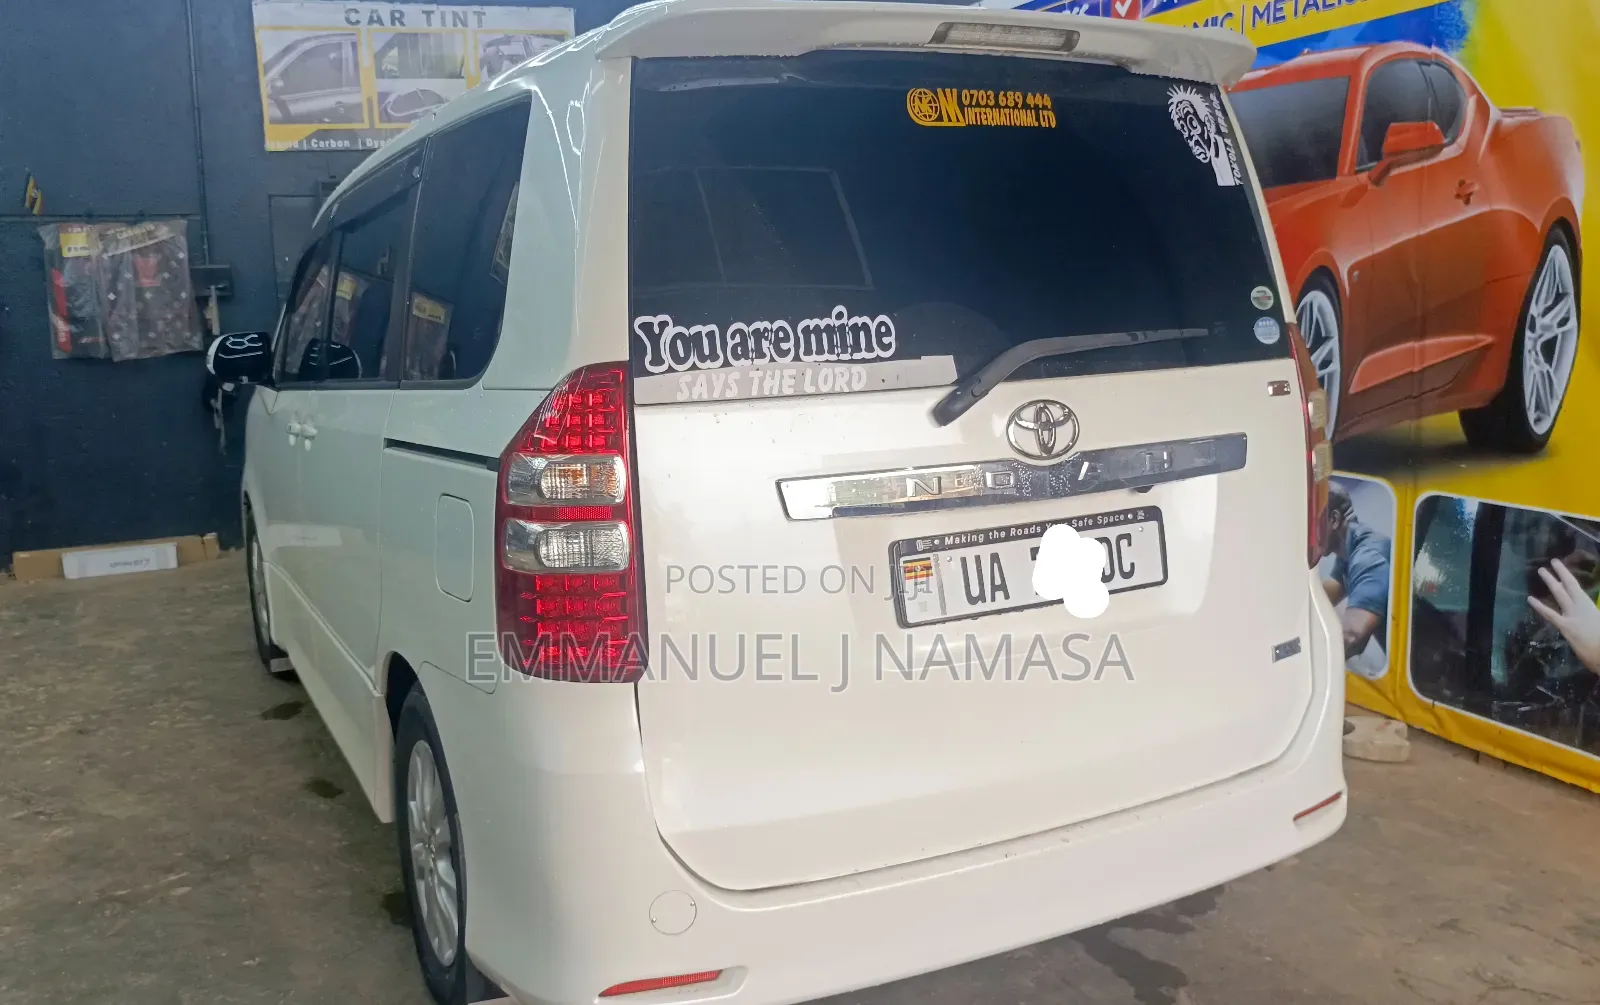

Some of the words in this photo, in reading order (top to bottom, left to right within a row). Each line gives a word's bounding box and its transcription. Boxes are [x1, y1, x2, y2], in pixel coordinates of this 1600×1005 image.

[344, 8, 406, 27] CAR
[421, 10, 486, 28] TINT
[1251, 0, 1358, 30] METAL
[961, 89, 995, 106] 0703
[998, 91, 1023, 107] 689
[1026, 92, 1052, 109] 444
[964, 107, 1039, 128] INTERNATIONAL
[1040, 110, 1057, 128] LTD
[311, 138, 350, 149] Carbon
[634, 314, 724, 374] You
[726, 321, 795, 364] are
[797, 305, 896, 363] mine
[676, 371, 741, 400] SAYS
[748, 367, 797, 396] THE
[803, 364, 868, 394] LORD
[944, 533, 985, 546] Making
[988, 529, 1006, 541] the
[1009, 525, 1042, 538] Roads
[1071, 517, 1094, 528] Safe
[1096, 513, 1125, 526] Space
[960, 552, 1010, 605] UA
